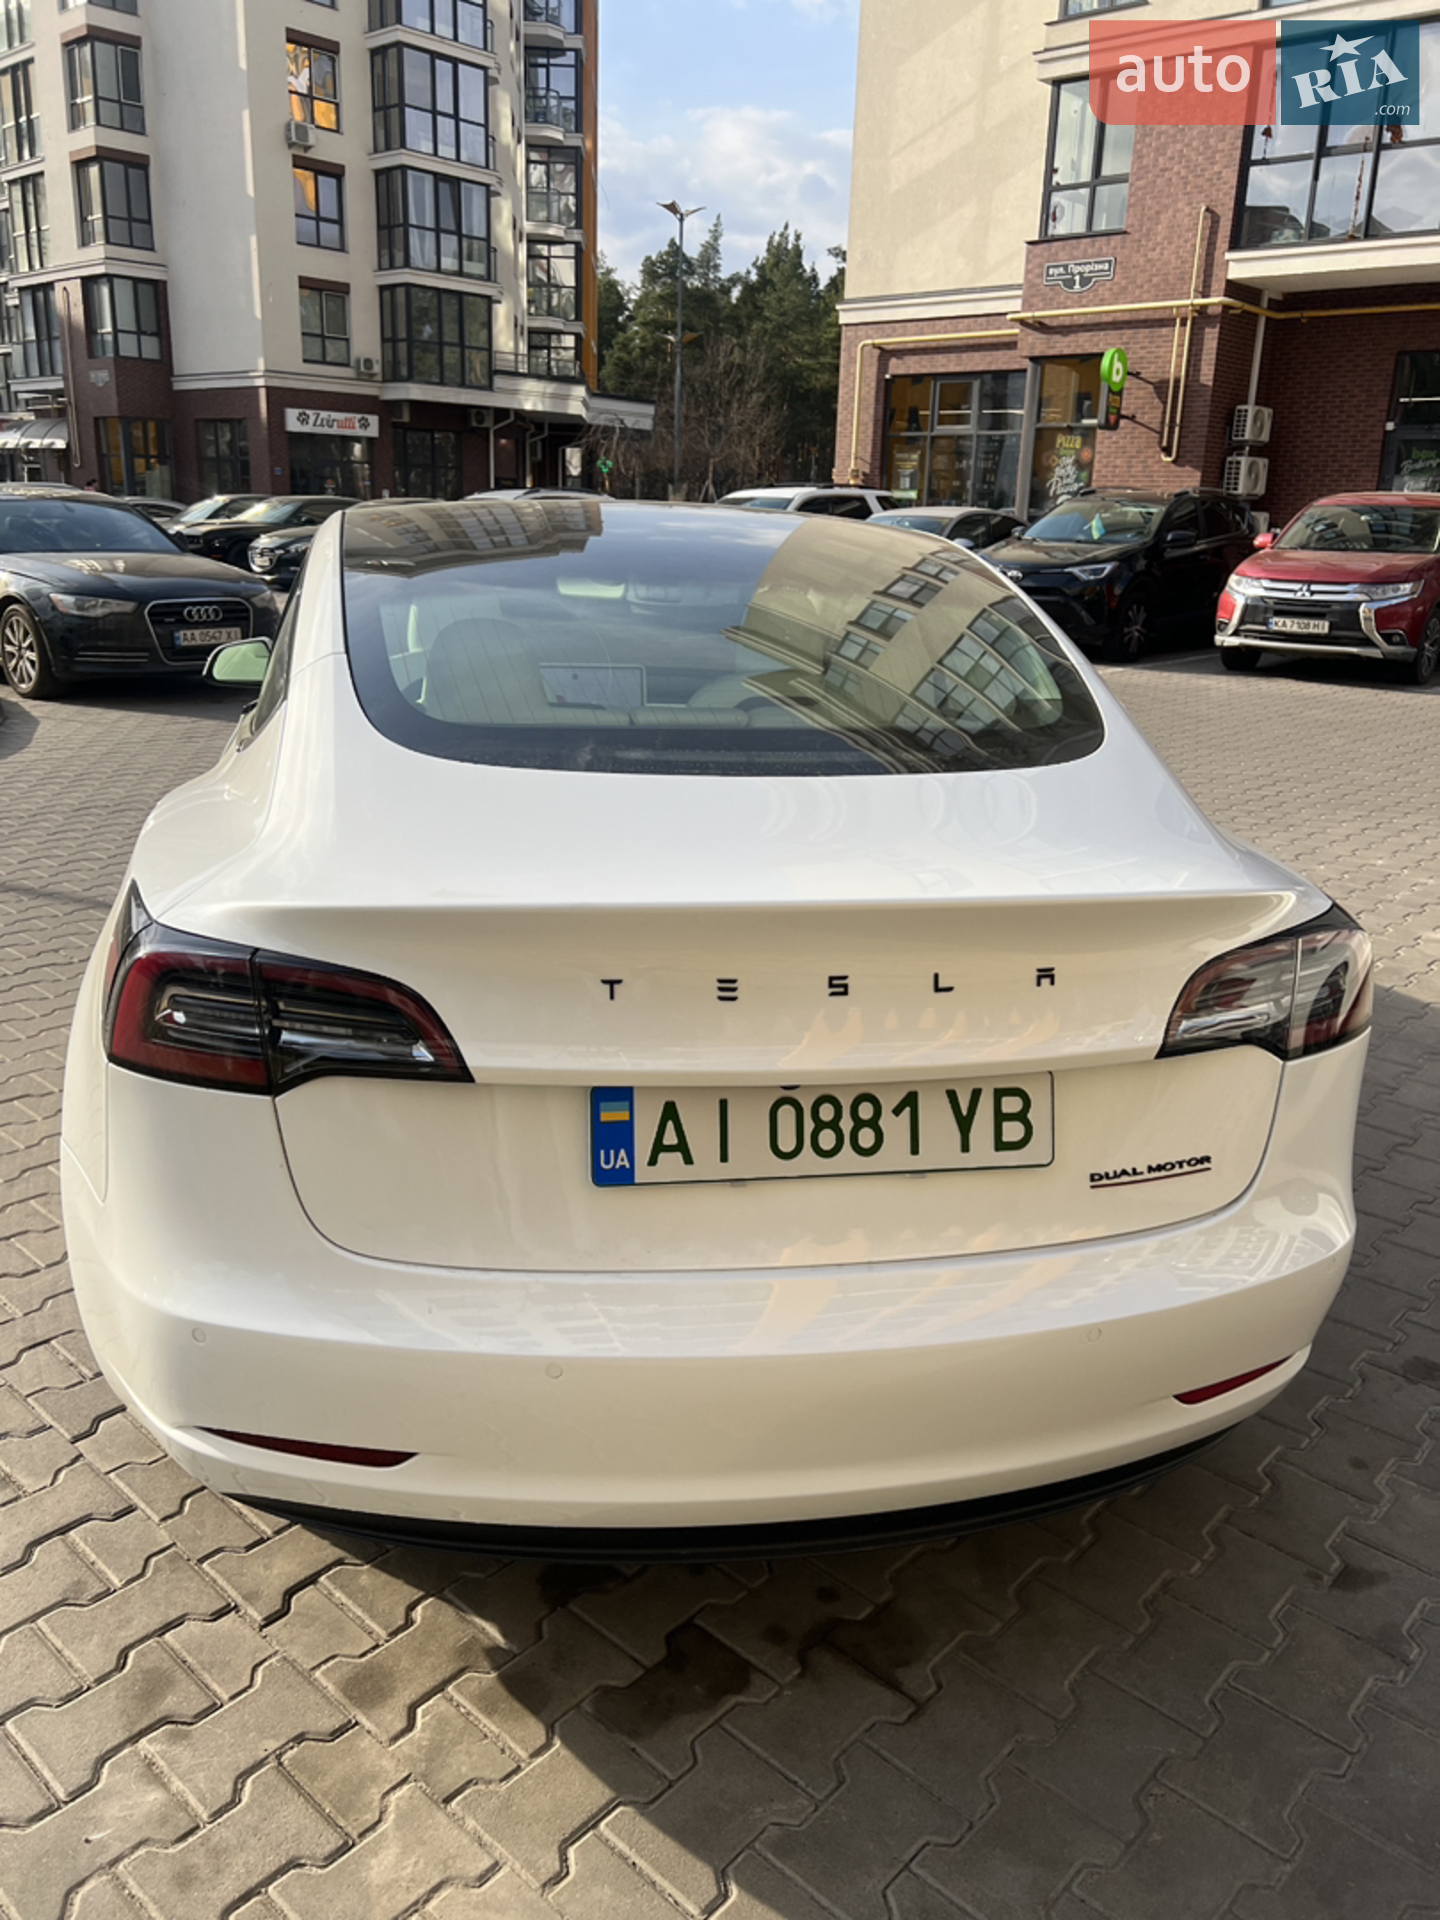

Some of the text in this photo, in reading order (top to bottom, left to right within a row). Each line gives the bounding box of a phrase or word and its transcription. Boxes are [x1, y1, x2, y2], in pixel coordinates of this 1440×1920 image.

[1048, 266, 1067, 277] вул.
[1073, 274, 1081, 289] 1
[1112, 352, 1124, 384] b
[1273, 619, 1287, 630] KA
[182, 631, 198, 644] AA
[600, 966, 1057, 1001] TESLA
[600, 1148, 630, 1170] UA
[768, 1090, 920, 1161] 0881
[945, 1086, 1034, 1154] YB
[1089, 1155, 1212, 1183] DUAL MOTOR
